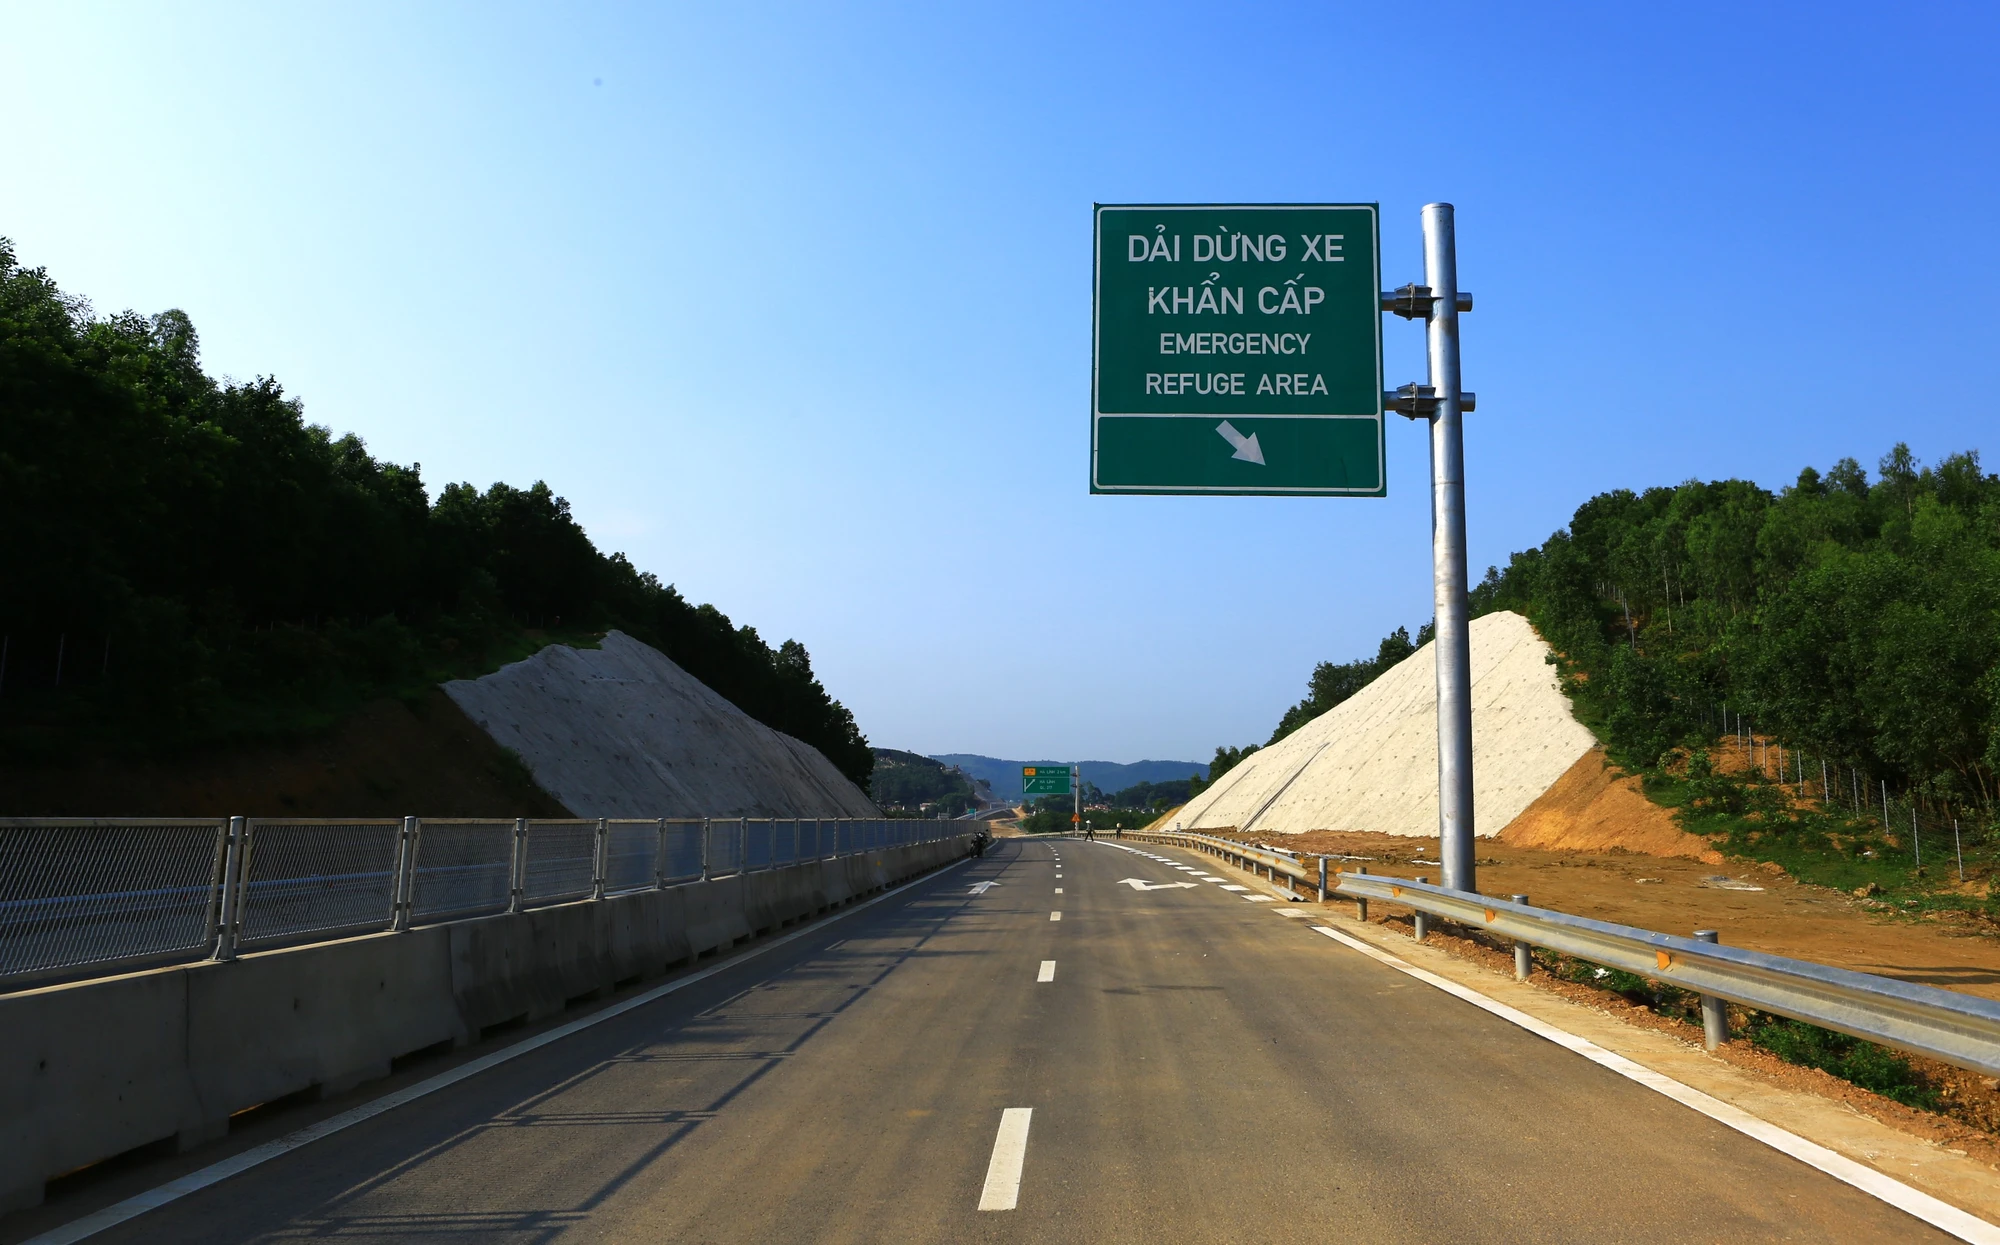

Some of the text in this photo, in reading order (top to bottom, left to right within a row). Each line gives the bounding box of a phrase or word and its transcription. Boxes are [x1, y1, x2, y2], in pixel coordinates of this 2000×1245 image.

[1128, 224, 1345, 262] DẢI DỪNG XE
[1148, 272, 1326, 315] KHẨN CẤP
[1160, 333, 1311, 355] EMERGENCY
[1146, 373, 1329, 396] REFUGE AREA
